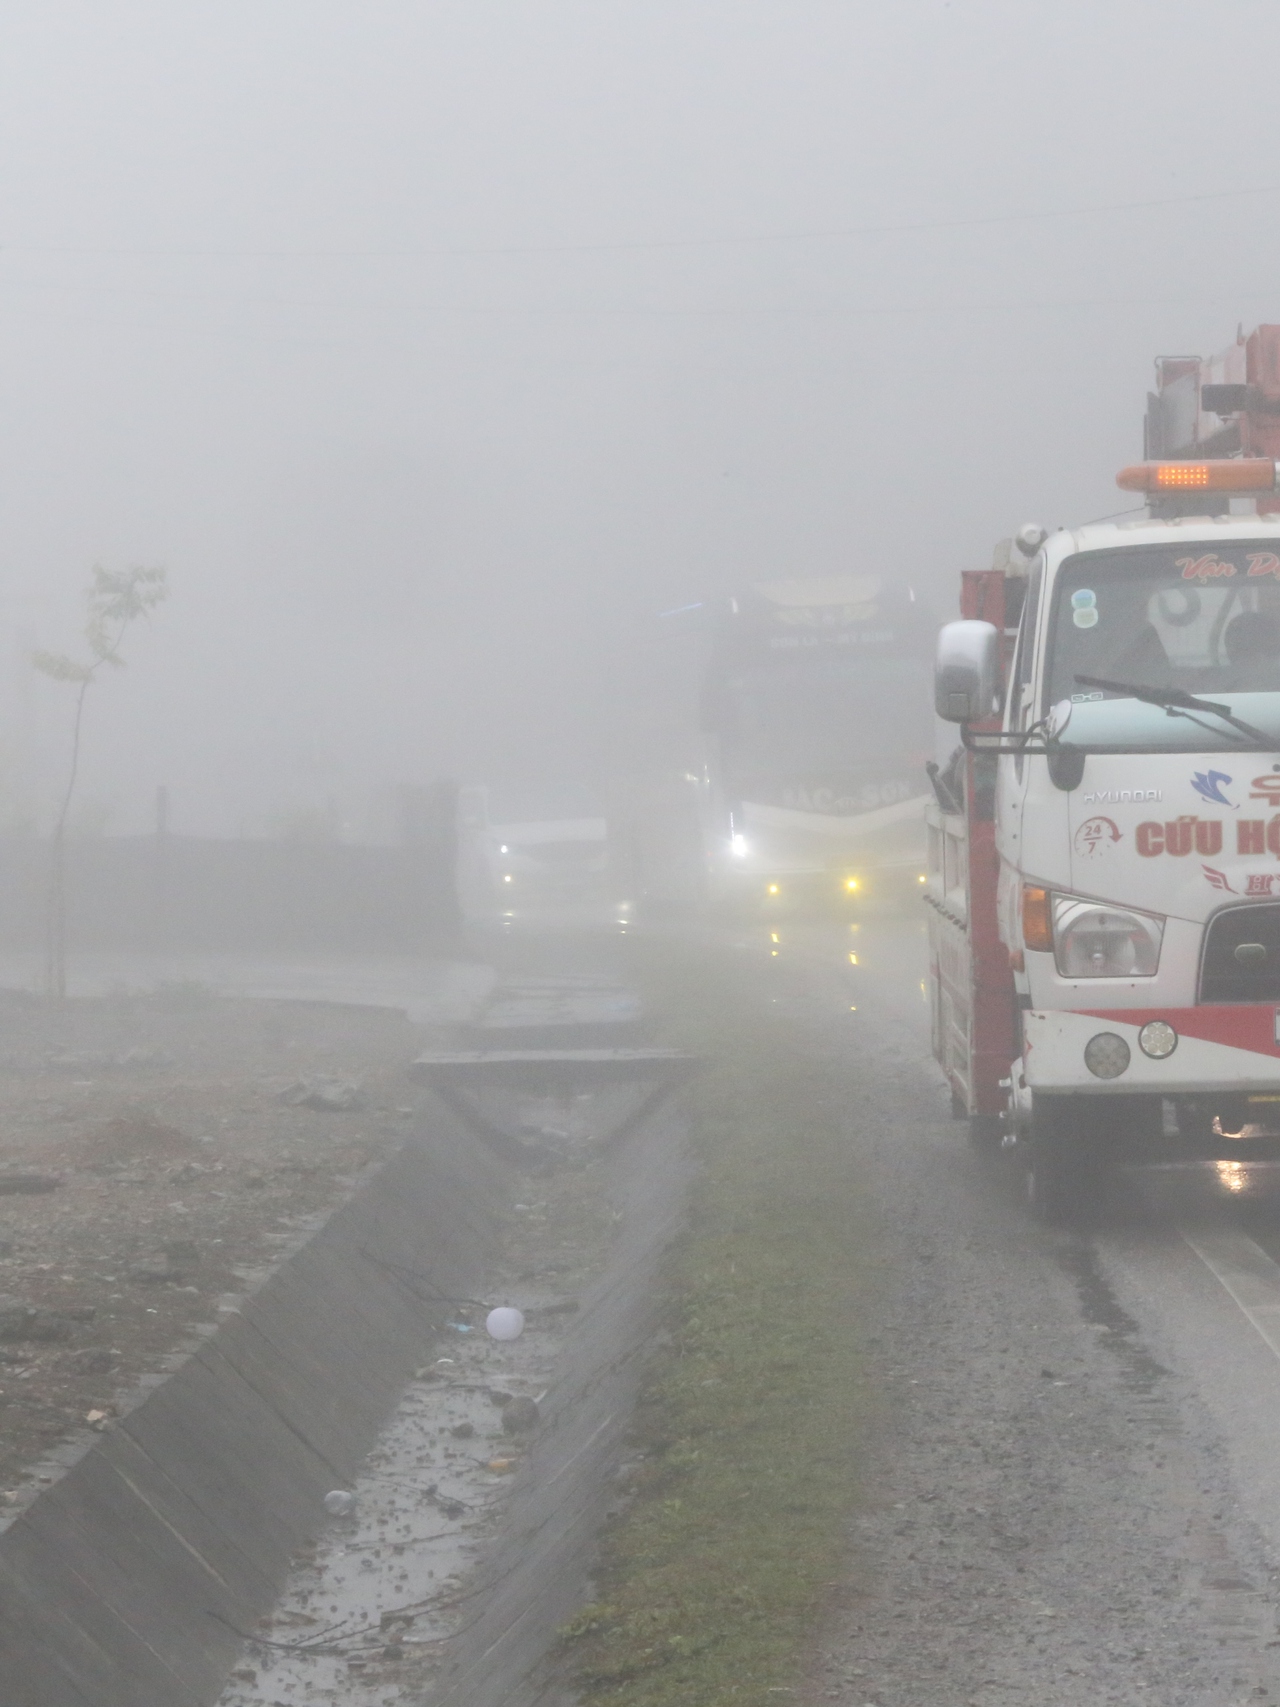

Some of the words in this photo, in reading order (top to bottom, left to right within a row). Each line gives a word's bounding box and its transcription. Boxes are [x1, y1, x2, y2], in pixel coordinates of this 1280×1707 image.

[1175, 554, 1237, 584] Vạn
[1083, 789, 1163, 804] HYUNDAI
[1085, 824, 1101, 836] 24
[1135, 815, 1223, 858] CỨU
[1088, 842, 1096, 854] 7
